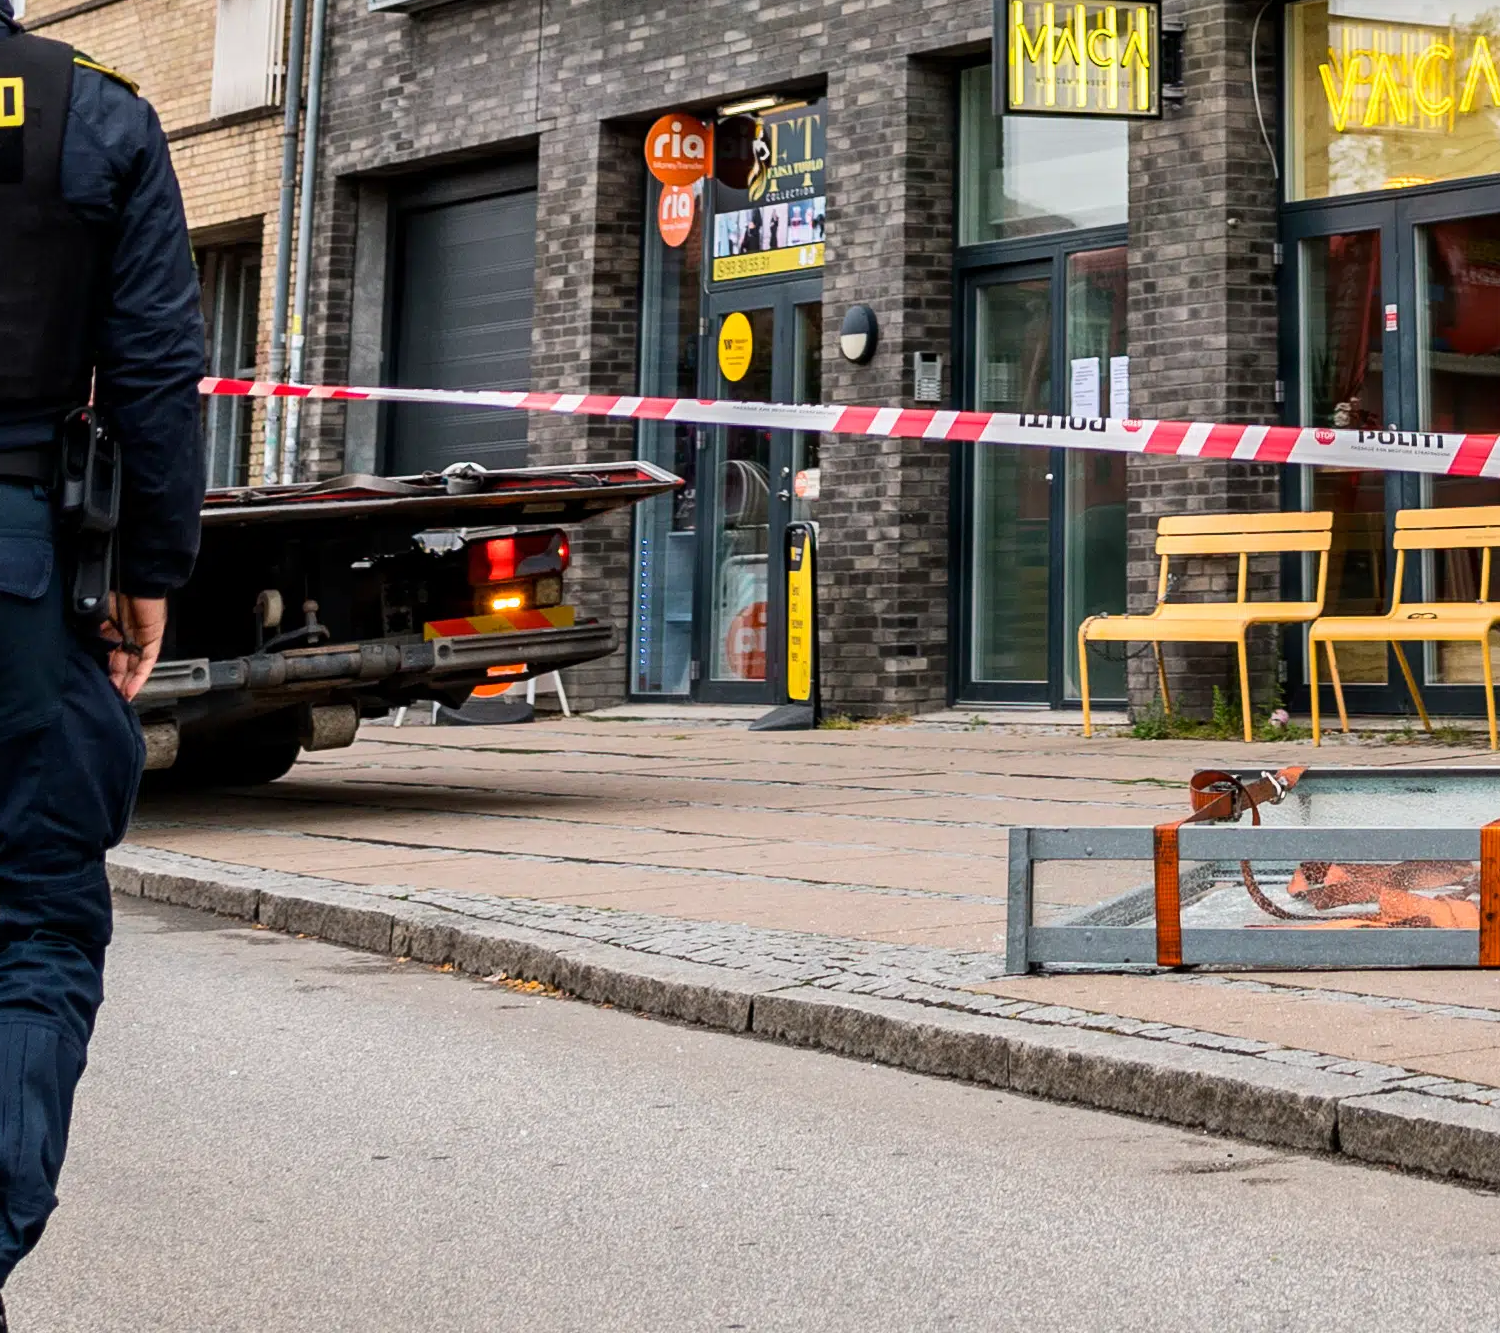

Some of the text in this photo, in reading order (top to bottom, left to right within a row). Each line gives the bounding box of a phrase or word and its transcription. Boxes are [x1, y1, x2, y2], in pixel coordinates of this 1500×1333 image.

[654, 121, 705, 159] ria
[661, 185, 690, 220] ria
[1358, 430, 1444, 449] POLITI
